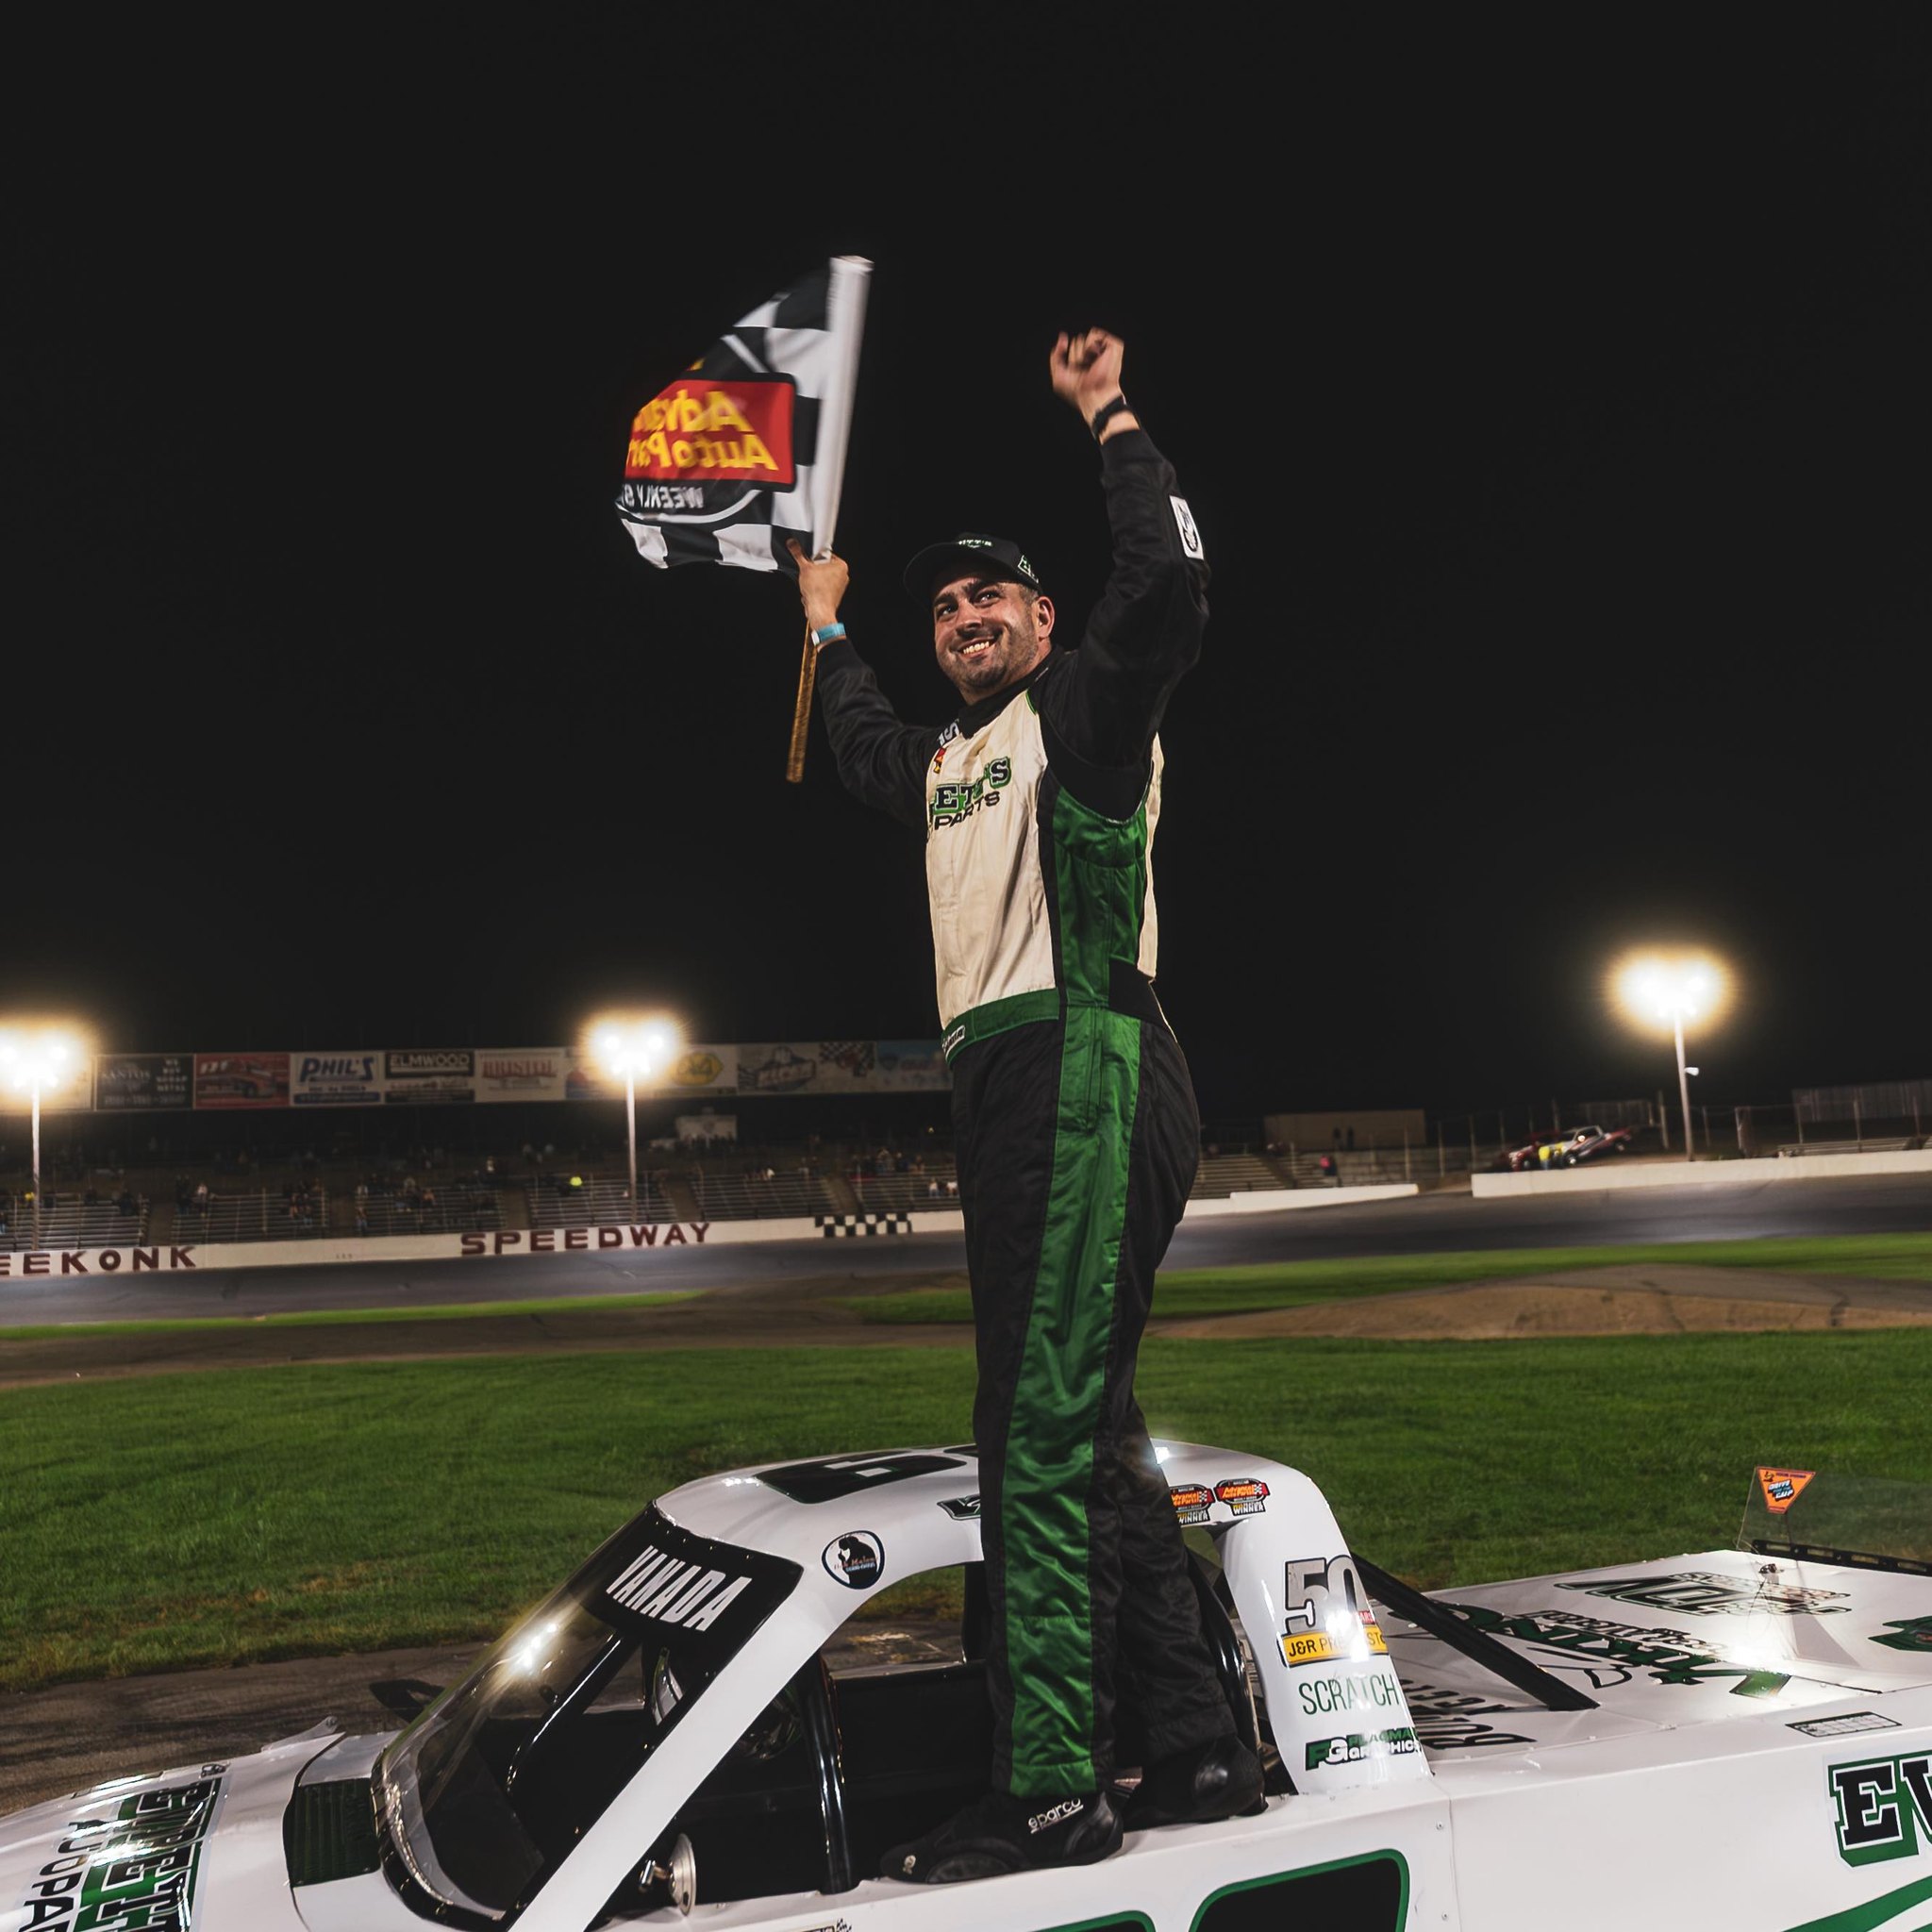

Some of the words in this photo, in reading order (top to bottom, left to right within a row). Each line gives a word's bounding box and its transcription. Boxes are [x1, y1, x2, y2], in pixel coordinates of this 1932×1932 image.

[933, 790, 1001, 830] PARTS
[300, 1057, 374, 1082] PHIL'S
[390, 1052, 470, 1068] ELMWOOD
[460, 1223, 711, 1257] SPEEDWAY
[1233, 1501, 1265, 1515] WINNER
[605, 1544, 753, 1633] VANADA
[1284, 1554, 1369, 1637] 50
[1289, 1639, 1317, 1657] J&R
[1298, 1674, 1399, 1715] SCRATCH
[1027, 1798, 1082, 1831] sparco
